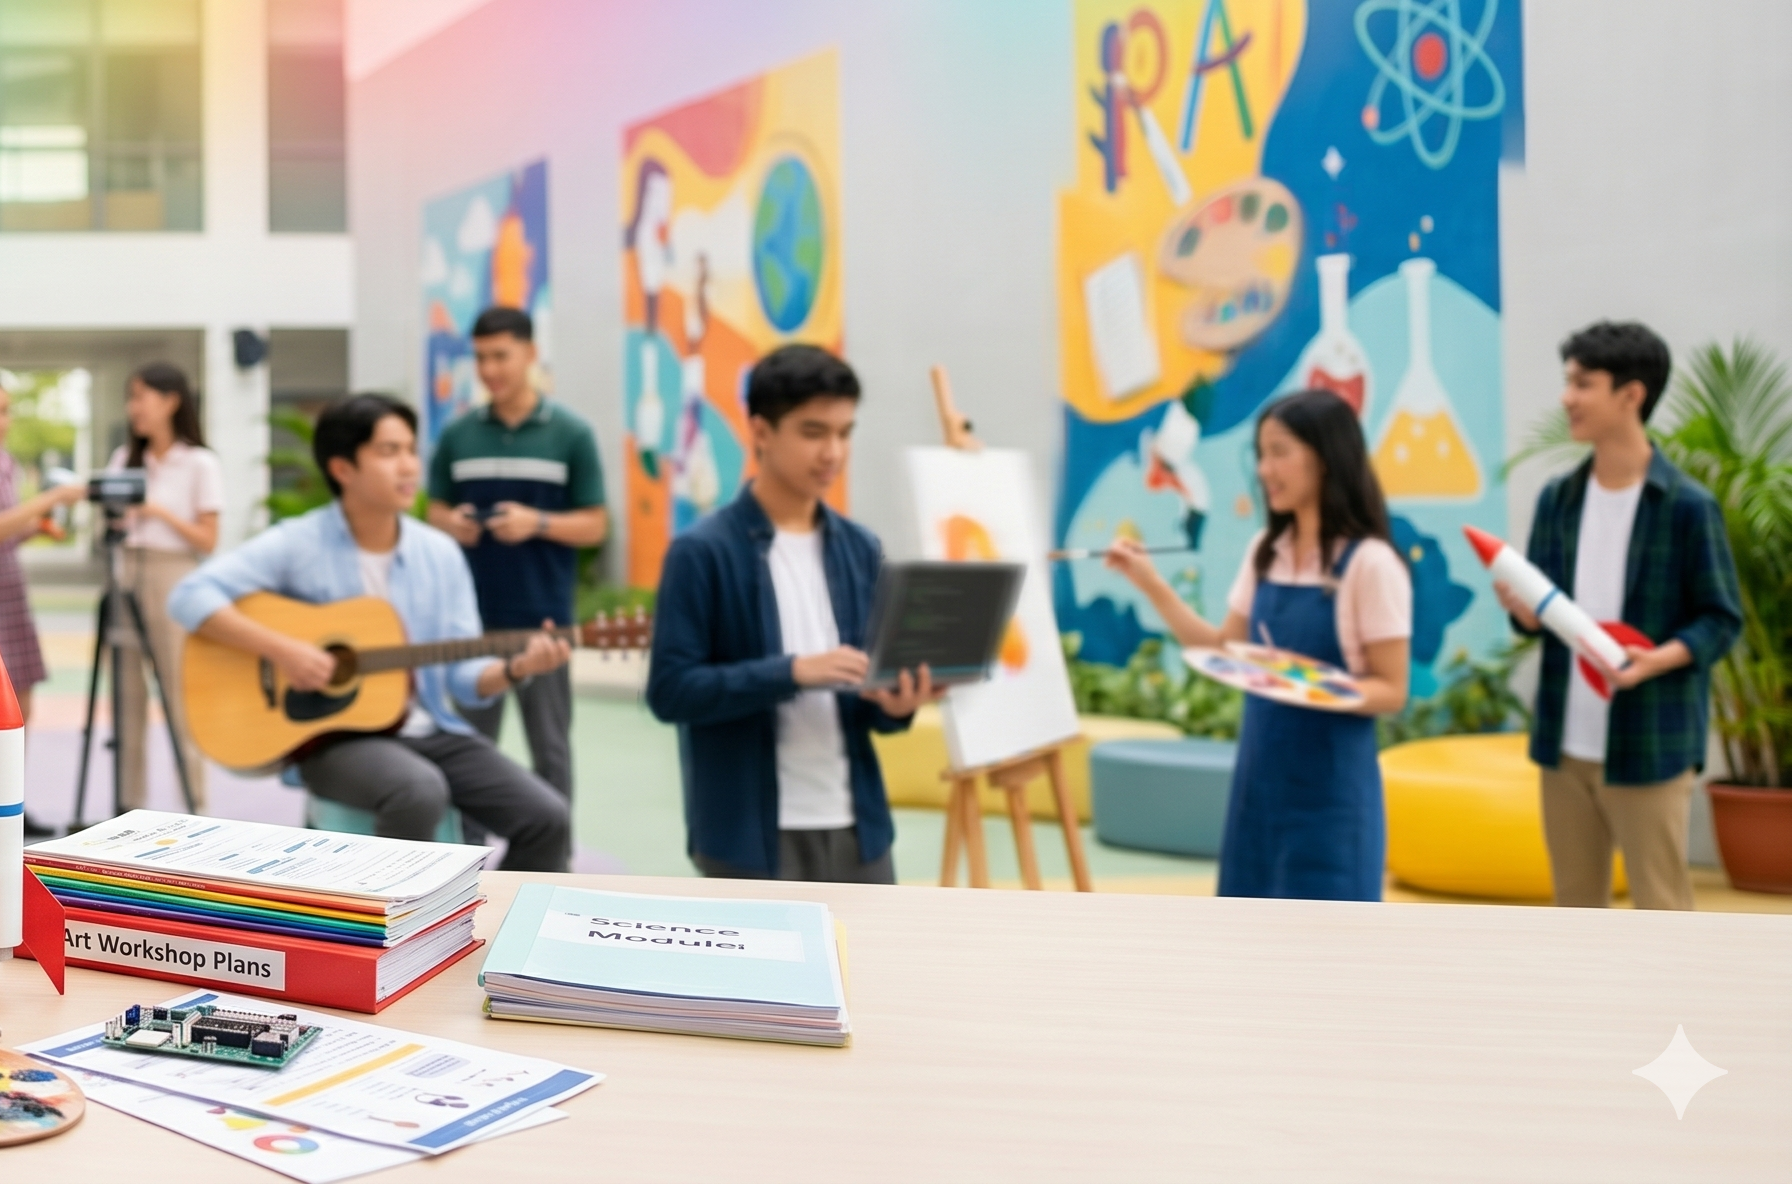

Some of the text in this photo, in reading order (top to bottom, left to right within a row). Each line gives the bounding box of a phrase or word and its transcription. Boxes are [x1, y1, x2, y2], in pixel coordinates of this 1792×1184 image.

[590, 917, 740, 936] Science
[64, 928, 271, 978] Art Workshop Plans
